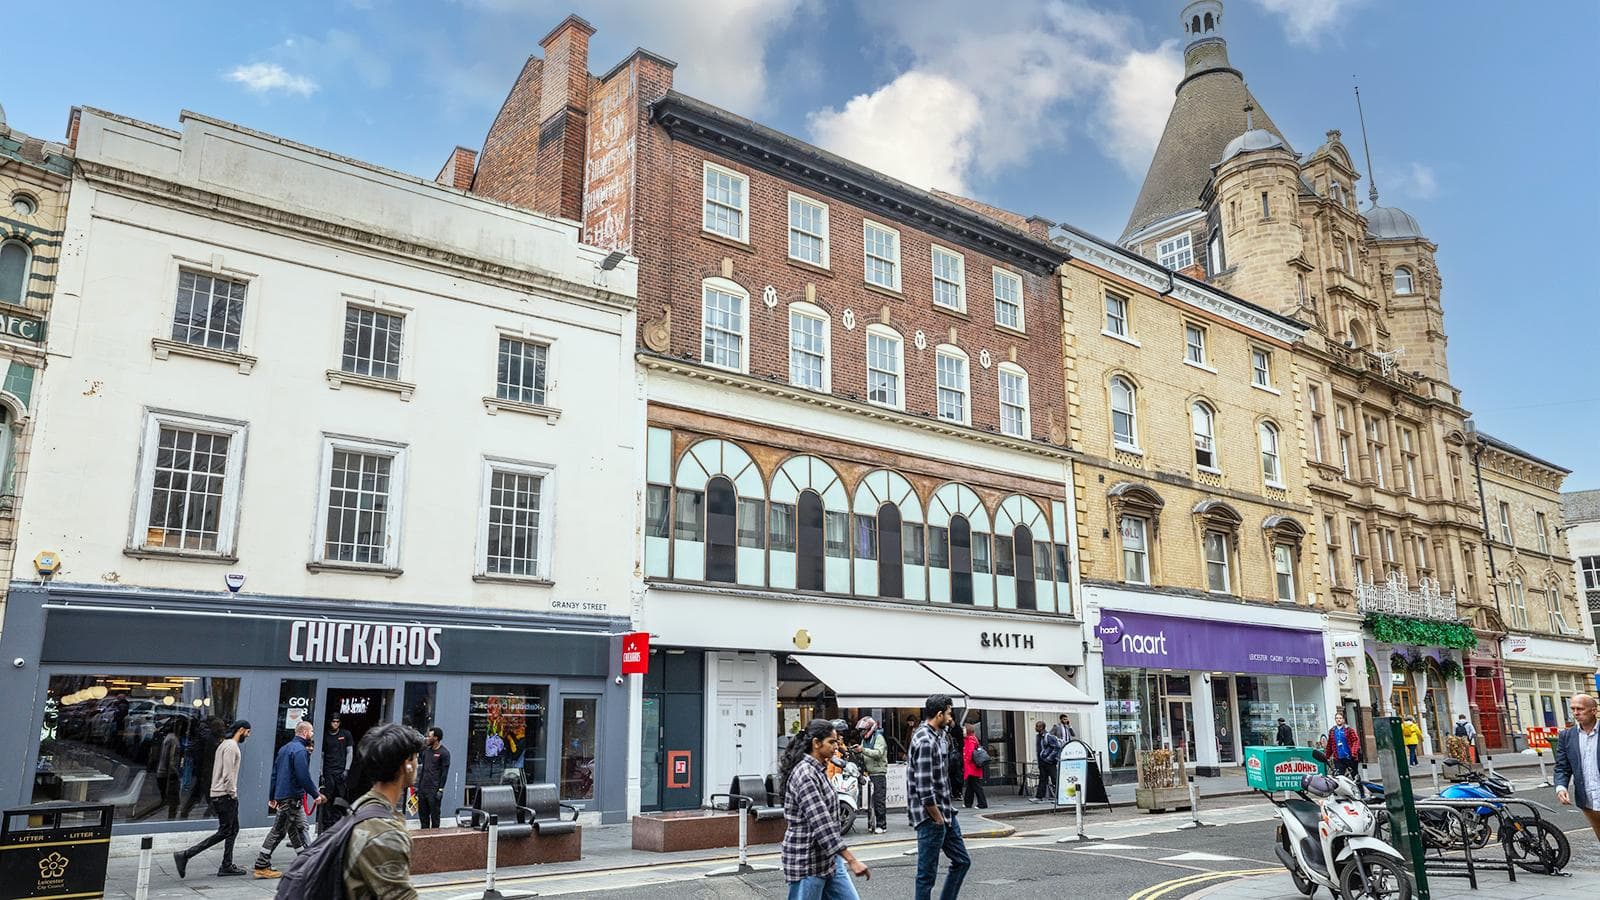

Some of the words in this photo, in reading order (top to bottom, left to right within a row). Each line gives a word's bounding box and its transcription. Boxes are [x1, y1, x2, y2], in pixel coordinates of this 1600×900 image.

[582, 602, 608, 611] STREET
[1100, 626, 1119, 634] haart
[289, 620, 442, 667] CHICKAROS
[980, 632, 1034, 649] &KITH
[1249, 653, 1268, 662] LEICESTER
[1275, 763, 1293, 773] PAPA
[1293, 762, 1318, 773] JOHN'S
[1275, 780, 1299, 788] BETTER
